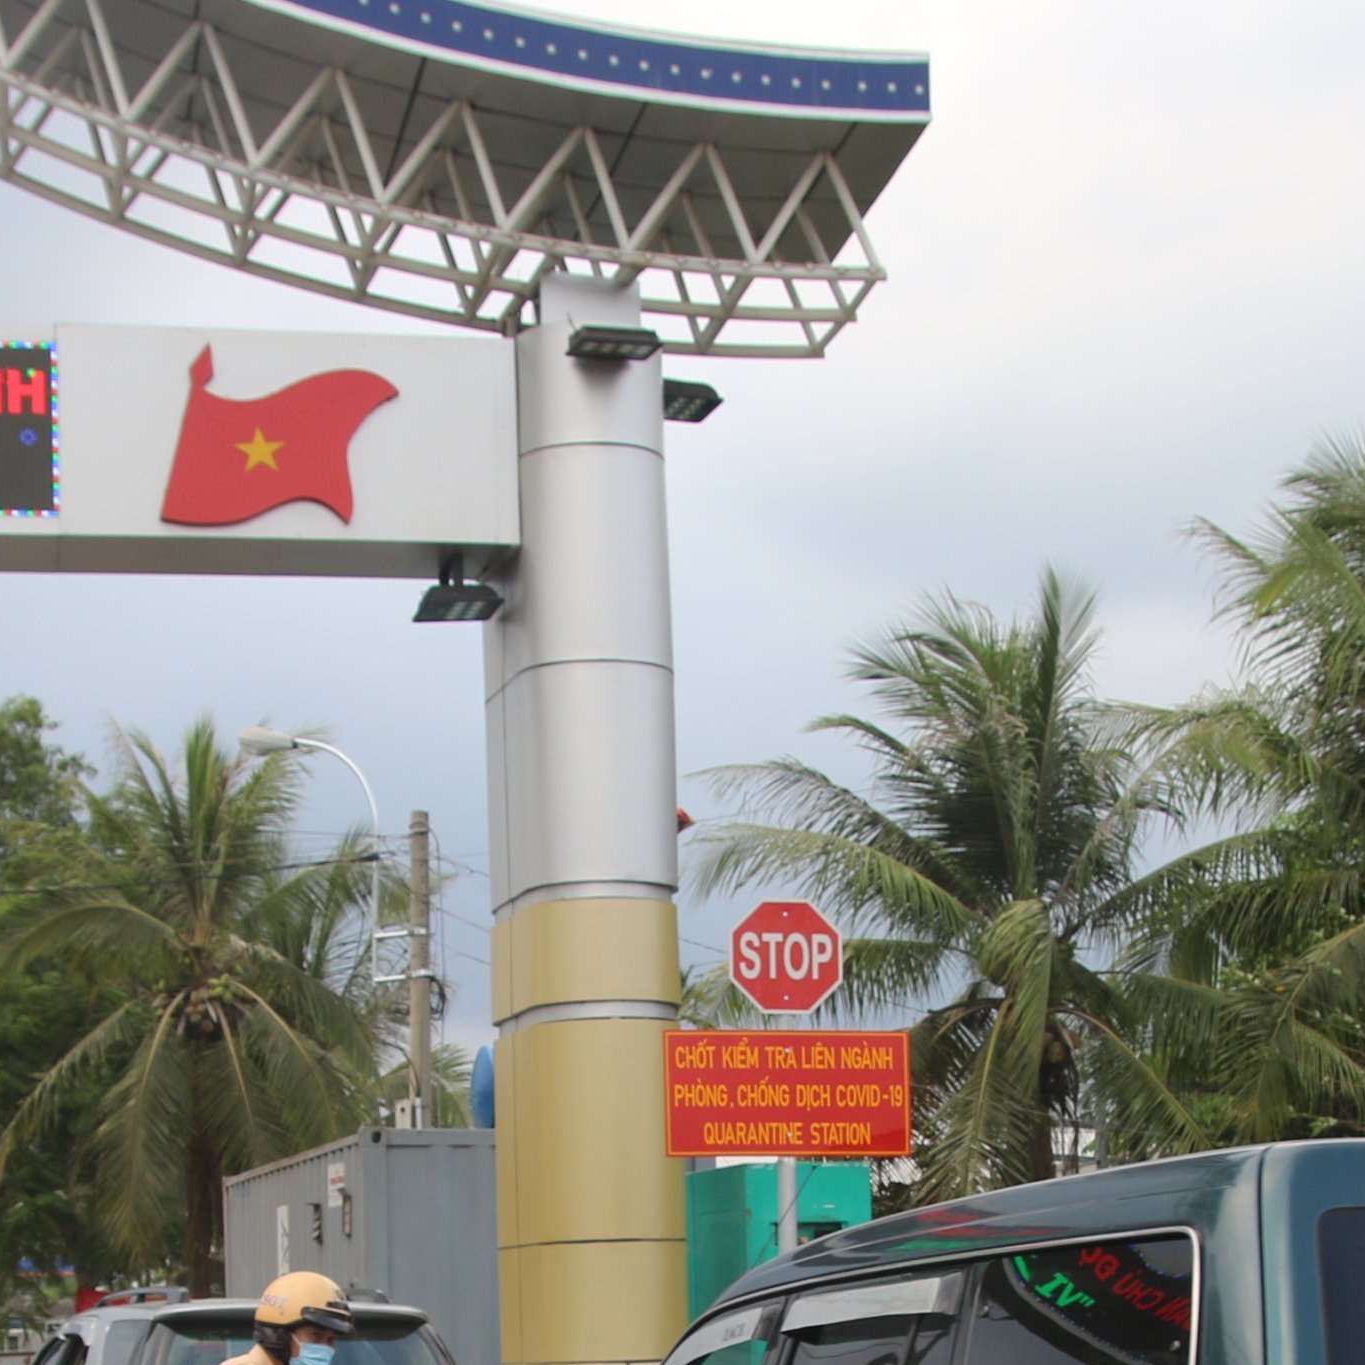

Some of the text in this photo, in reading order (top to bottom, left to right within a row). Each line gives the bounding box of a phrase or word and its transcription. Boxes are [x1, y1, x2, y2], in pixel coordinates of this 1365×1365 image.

[739, 932, 833, 980] STOP
[675, 1037, 893, 1070] CHỐT KIỂM TRA LIÊN NGÀNH
[737, 1076, 790, 1107] CHỐNG
[796, 1084, 831, 1112] DỊCH
[703, 1122, 871, 1145] QUARANTINE STATION
